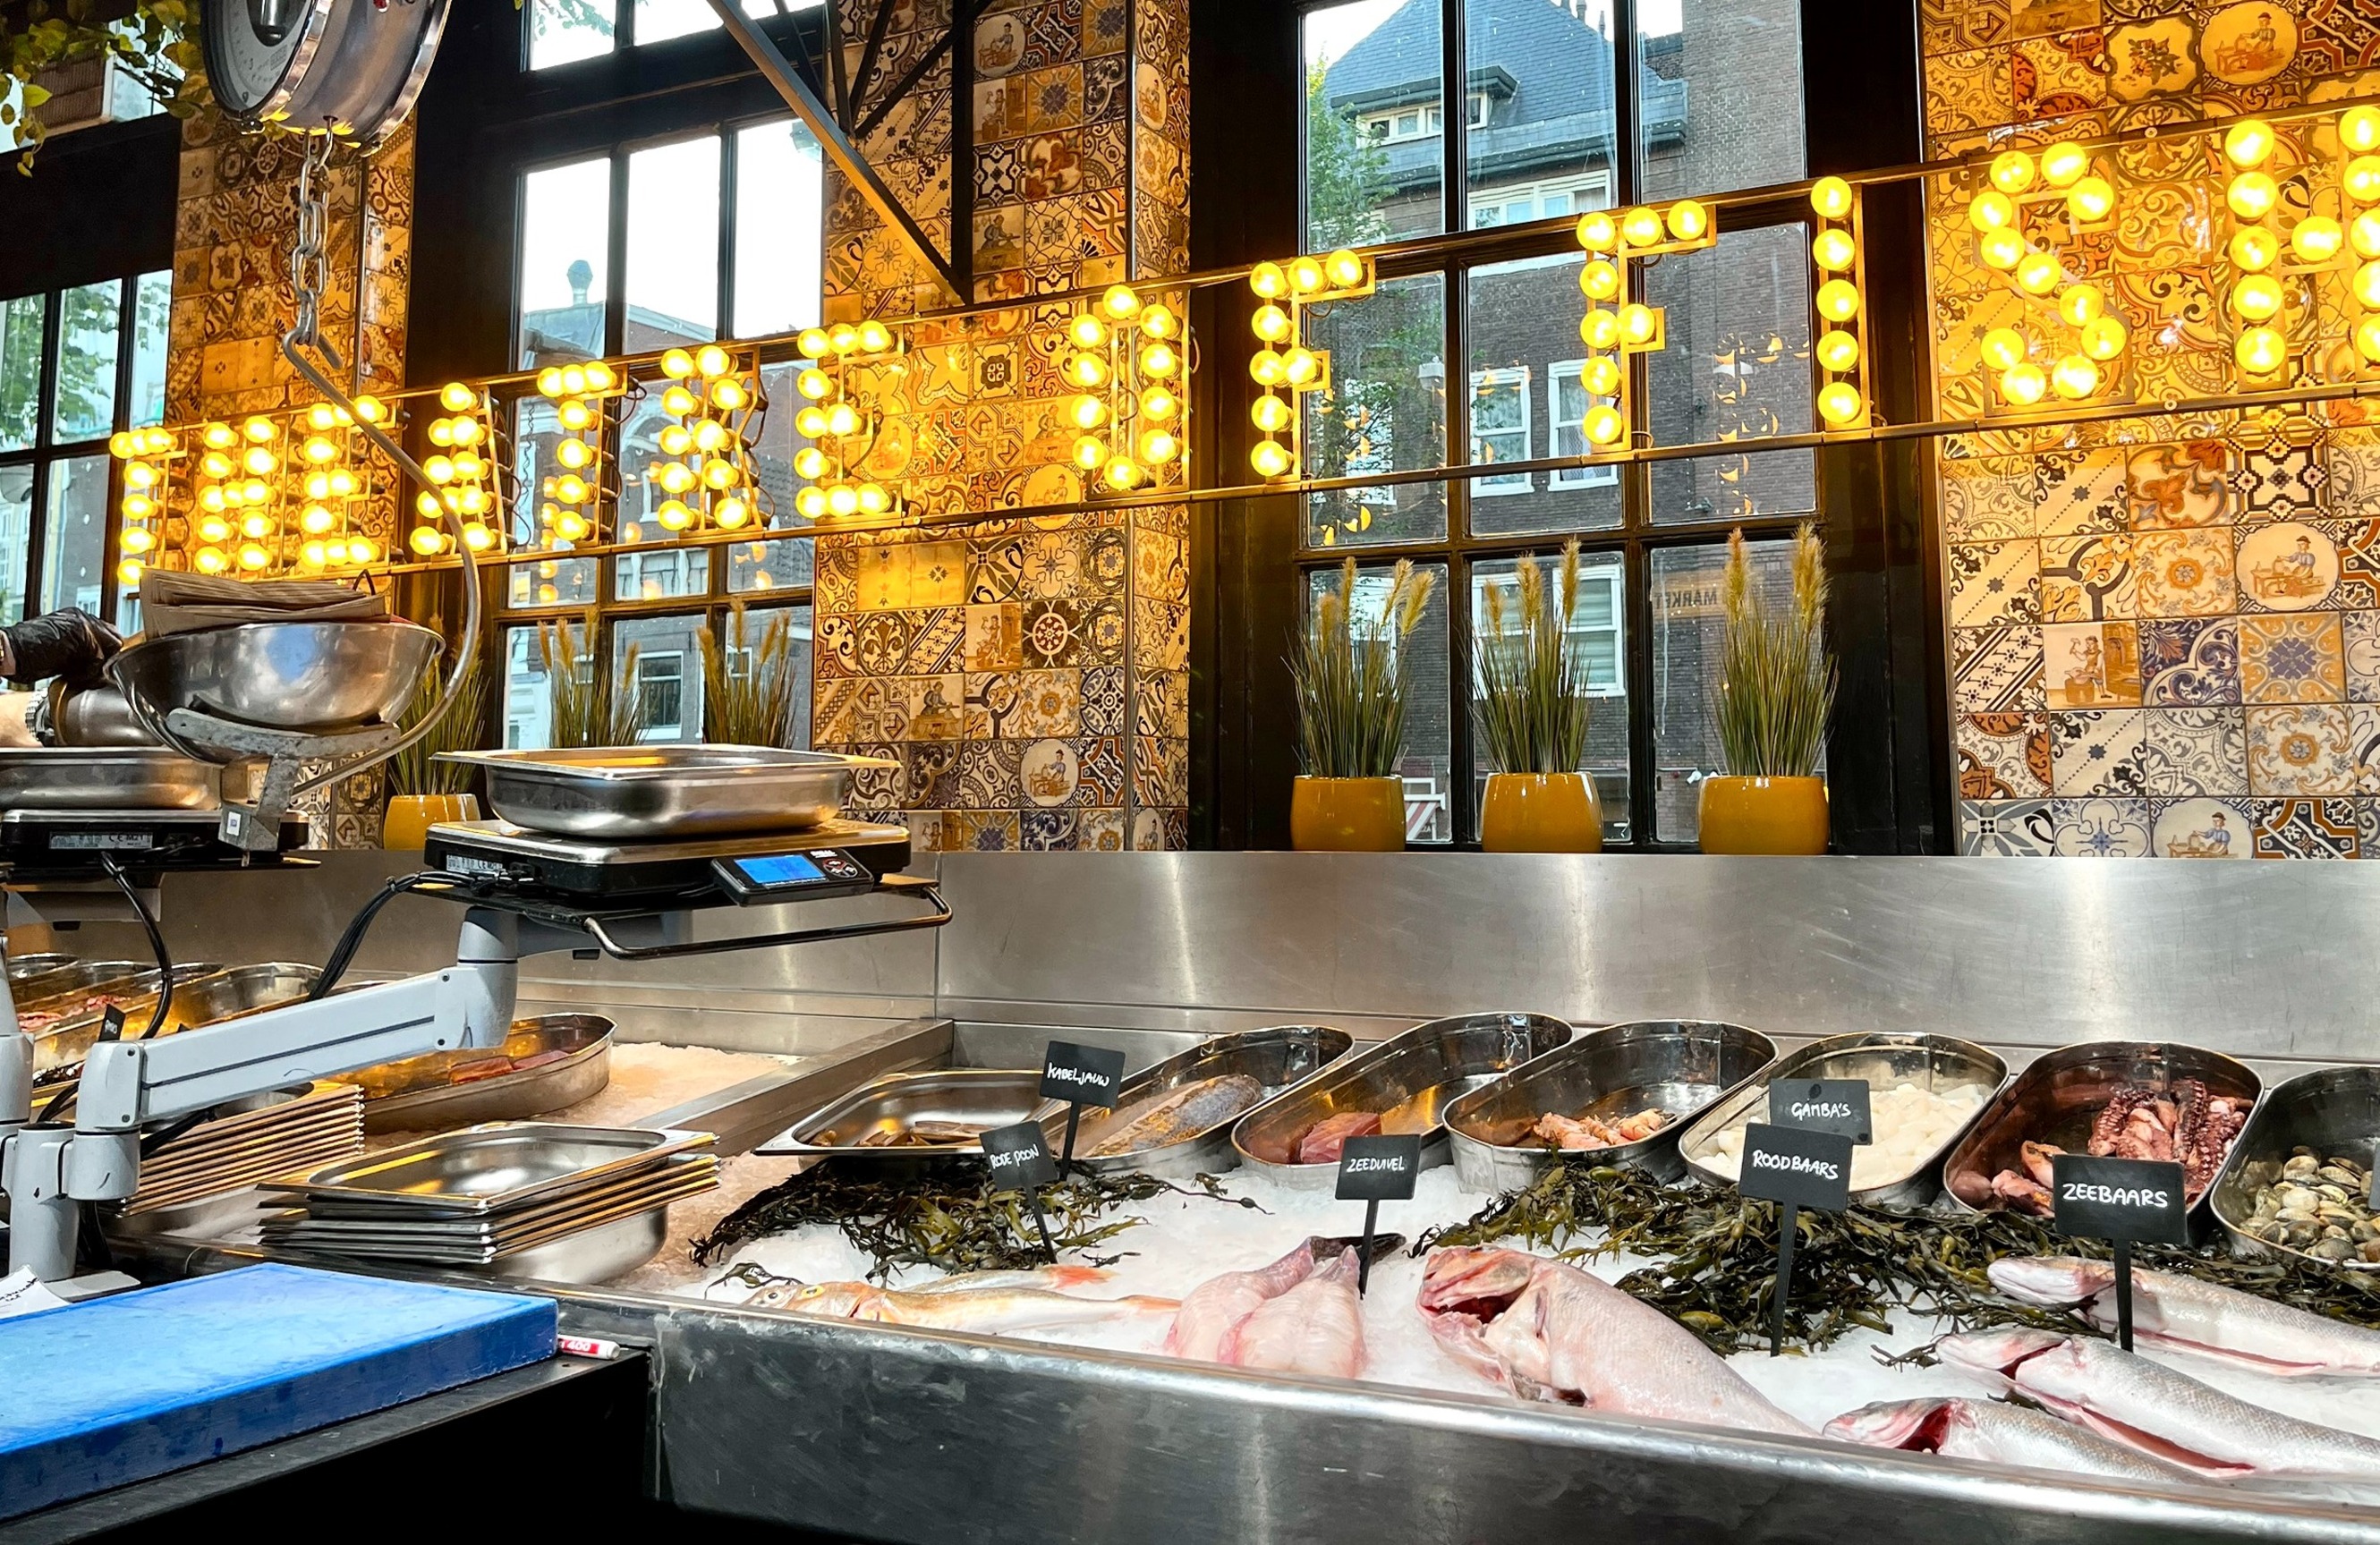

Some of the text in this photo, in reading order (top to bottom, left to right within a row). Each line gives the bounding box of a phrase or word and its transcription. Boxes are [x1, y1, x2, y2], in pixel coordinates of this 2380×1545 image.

[1069, 249, 1365, 491] OF
[1577, 104, 2380, 456] FISH
[1047, 1062, 1110, 1087] KABELJAUW
[1790, 1101, 1852, 1121] GAMBA'S
[990, 1143, 1040, 1169] RODE POON
[1346, 1155, 1405, 1173] ZEEDUIVEL
[1752, 1149, 1839, 1180] ROODBAARS
[2062, 1183, 2168, 1209] ZEEBAARS
[566, 1340, 591, 1352] 400
